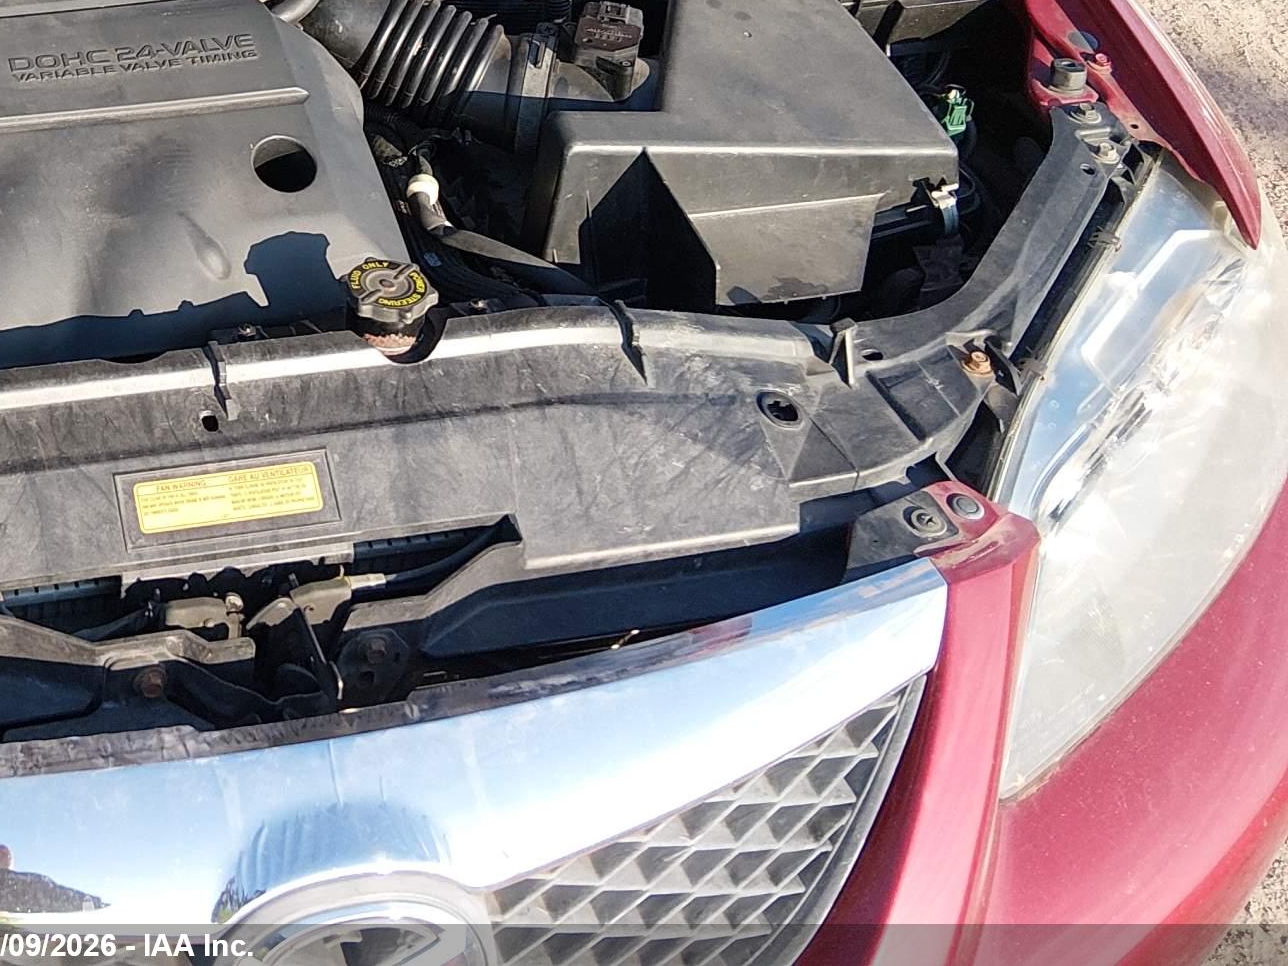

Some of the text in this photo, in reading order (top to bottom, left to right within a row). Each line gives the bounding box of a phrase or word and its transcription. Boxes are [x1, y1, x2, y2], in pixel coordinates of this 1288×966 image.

[8, 33, 255, 72] DOHC 24-VALVE
[12, 49, 258, 83] VARIABLE VALVE TIMING
[362, 261, 389, 271] ONLY
[156, 480, 207, 492] FAN WARNING
